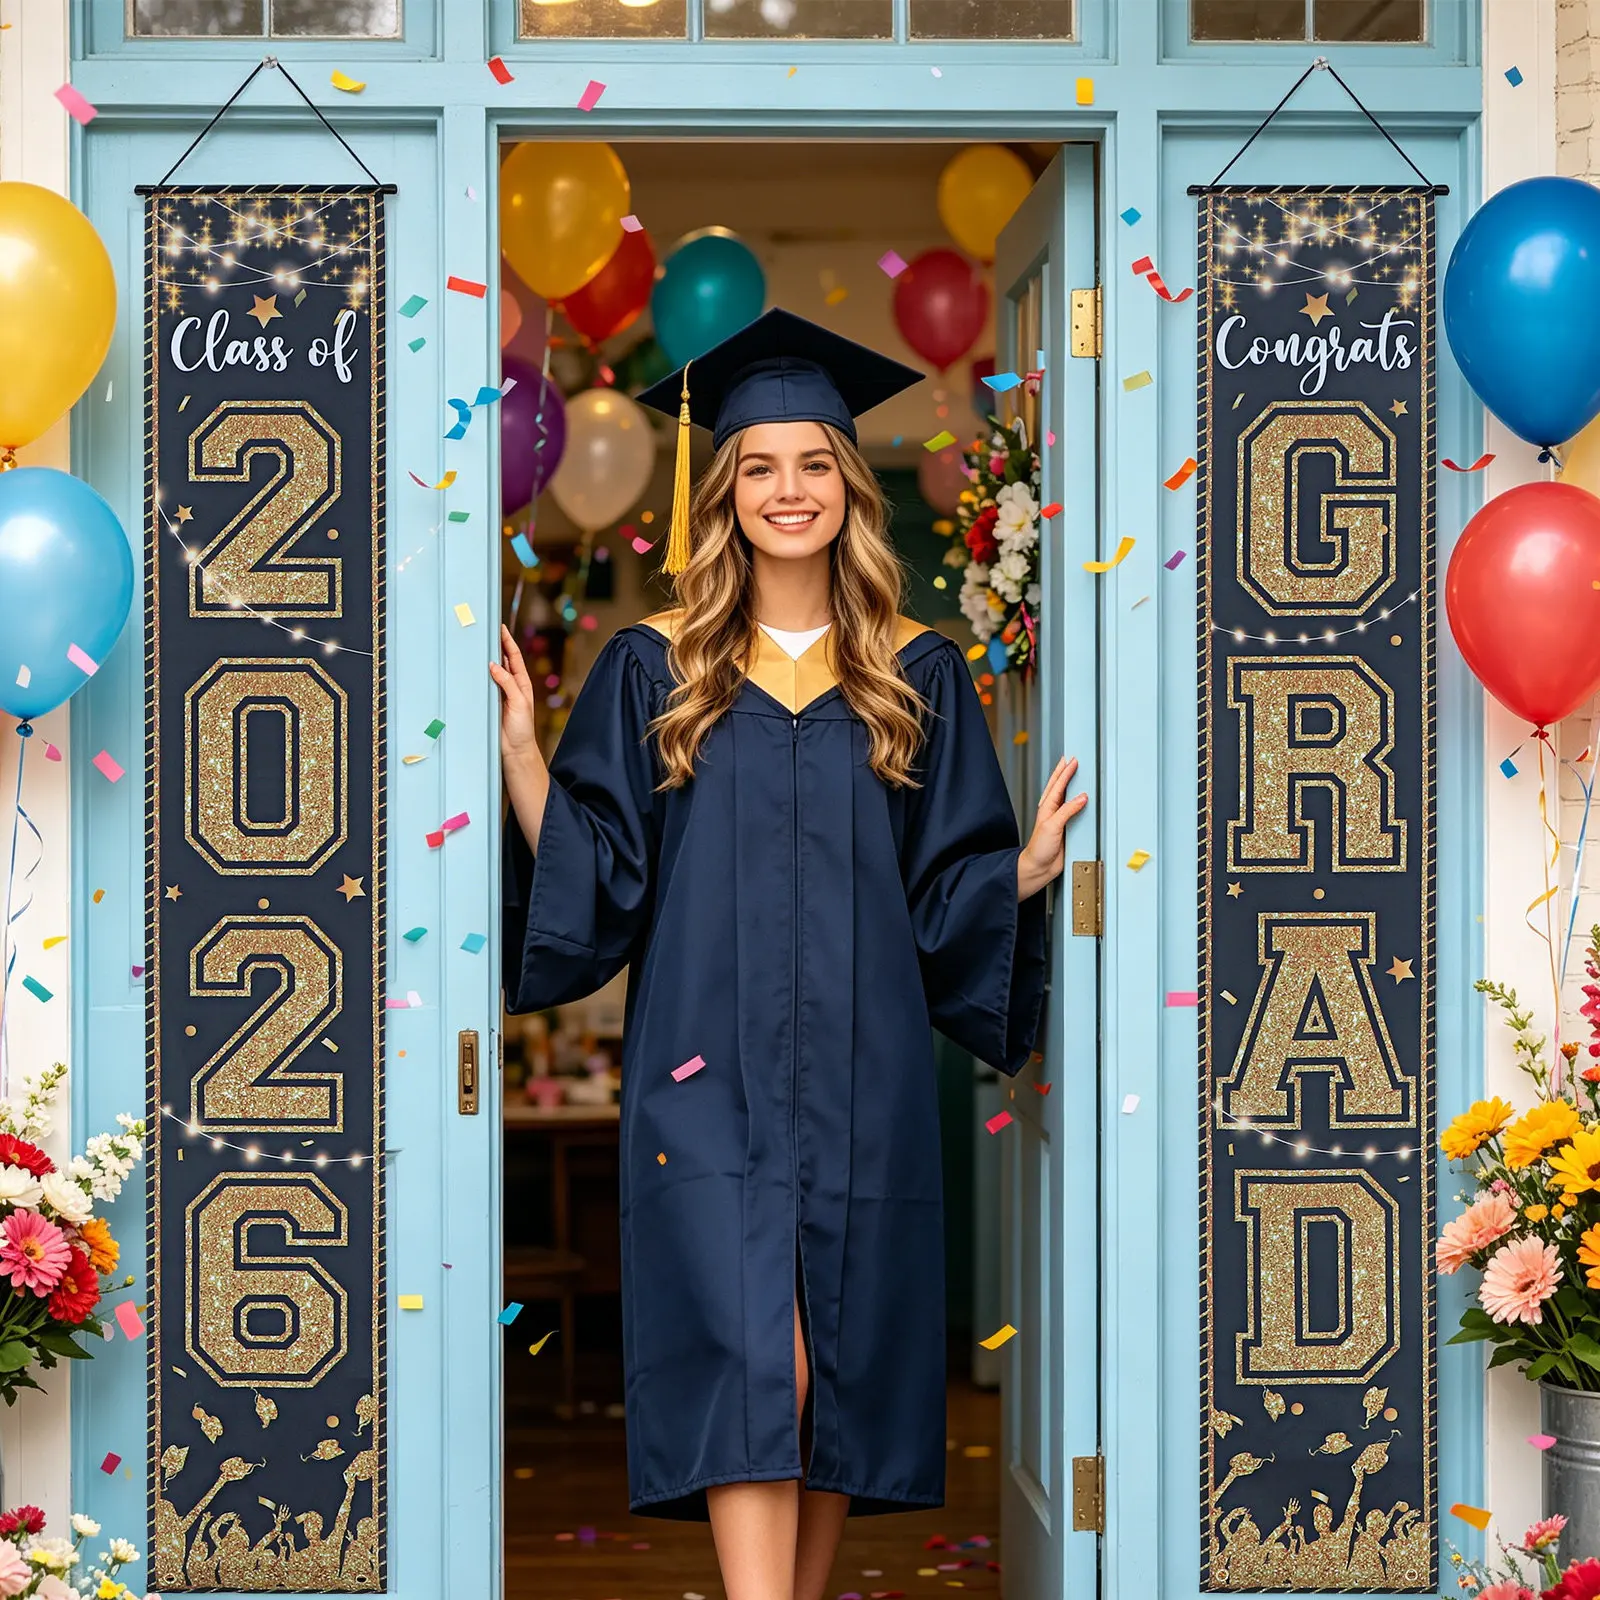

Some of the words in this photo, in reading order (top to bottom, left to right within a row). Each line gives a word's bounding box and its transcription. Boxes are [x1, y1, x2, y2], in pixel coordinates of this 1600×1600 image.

[170, 309, 294, 373] Class
[308, 309, 359, 384] of
[1215, 309, 1418, 396] Congrats
[184, 400, 348, 1389] 2026
[1216, 400, 1417, 1386] GRAD
